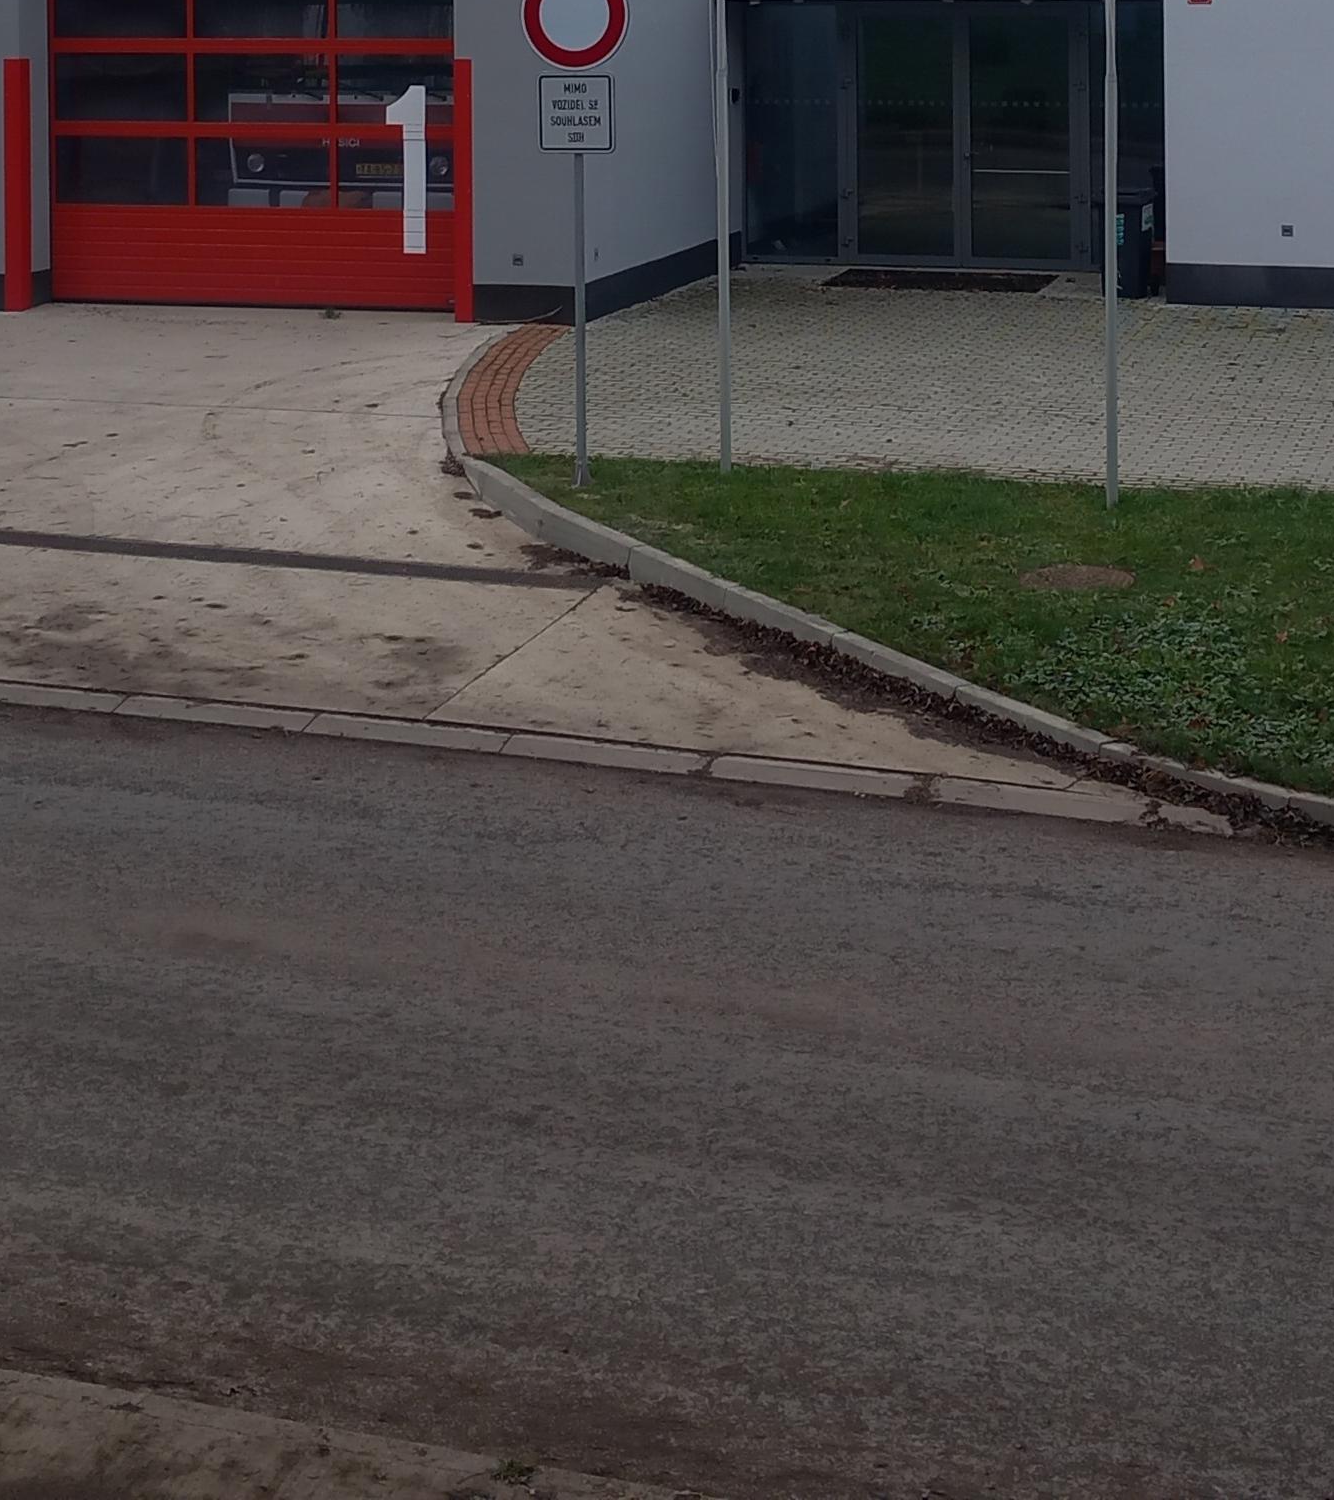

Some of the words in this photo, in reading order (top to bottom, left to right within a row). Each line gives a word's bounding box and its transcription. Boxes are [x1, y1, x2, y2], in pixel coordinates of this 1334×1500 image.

[563, 82, 587, 94] MIMO
[551, 99, 585, 110] VOZIDEL
[550, 115, 602, 127] SOUHLASEM
[386, 85, 426, 254] 1
